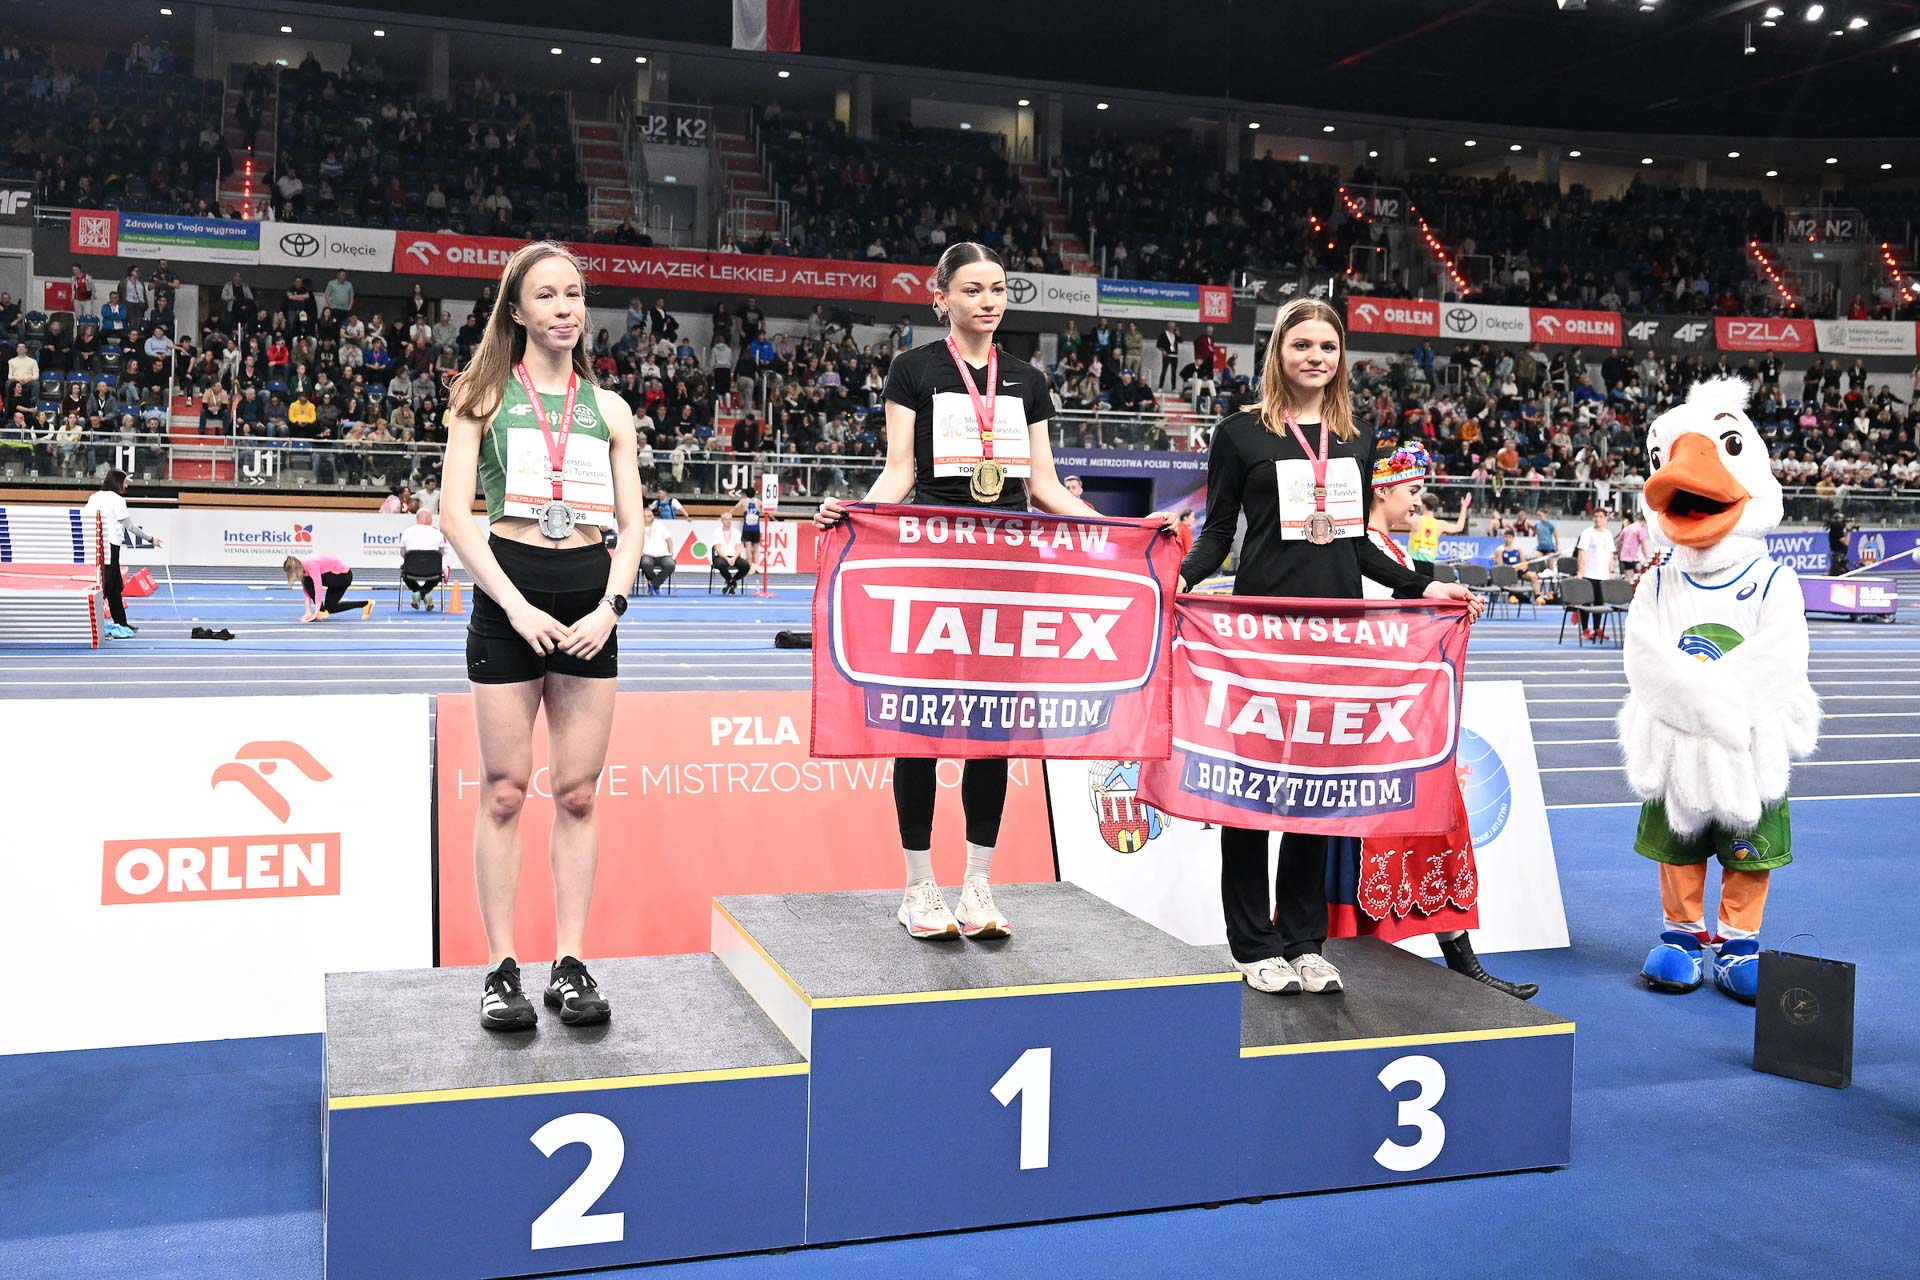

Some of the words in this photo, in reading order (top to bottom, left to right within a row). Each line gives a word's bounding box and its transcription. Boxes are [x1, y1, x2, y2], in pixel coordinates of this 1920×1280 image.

[641, 115, 668, 136] J2
[676, 117, 707, 139] K2
[1373, 198, 1399, 217] M2
[124, 219, 164, 229] Zdrowie
[165, 222, 175, 230] to
[177, 222, 203, 233] Twoja
[205, 226, 247, 236] wygrana
[1788, 220, 1817, 237] M2
[1825, 219, 1852, 237] N2
[330, 242, 377, 257] Okęcie
[578, 256, 607, 272] SKI
[612, 258, 705, 279] ZWIĄZEK
[710, 264, 786, 283] LEKKIEJ
[792, 270, 877, 288] ATLETYKI
[1048, 288, 1091, 303] Okęcie
[1278, 282, 1298, 294] 4F
[1383, 308, 1433, 325] ORLEN
[1485, 315, 1524, 332] Okęcie
[1565, 319, 1615, 335] ORLEN
[1628, 320, 1659, 340] 4F
[1673, 323, 1708, 342] 4F
[1728, 322, 1801, 341] PZLA
[508, 403, 533, 416] 4F
[242, 450, 273, 477] J1
[1089, 458, 1143, 468] MISTRZOSTWA
[1144, 460, 1170, 469] POLSKI
[1172, 460, 1198, 470] TORUŃ
[722, 464, 749, 490] J1
[765, 484, 778, 499] 60
[224, 530, 292, 544] InterRisk
[363, 532, 402, 544] Inter
[759, 529, 787, 549] UŃ
[898, 516, 1110, 554] BORYSŁAW
[224, 547, 250, 555] VIENNA
[1437, 541, 1479, 558] ORSKI
[1767, 537, 1814, 553] JAWY
[862, 584, 1134, 662] TALEX
[1213, 612, 1409, 648] BORYSŁAW
[879, 693, 1103, 729] BORZYTUCHOM
[1187, 659, 1428, 746] TALEX
[711, 716, 800, 746] PZLA
[1198, 762, 1402, 808] BORZYTUCHOM
[114, 842, 326, 895] ORLEN
[989, 1047, 1052, 1170] 1
[1372, 1054, 1447, 1171] 3
[529, 1112, 626, 1250] 2
